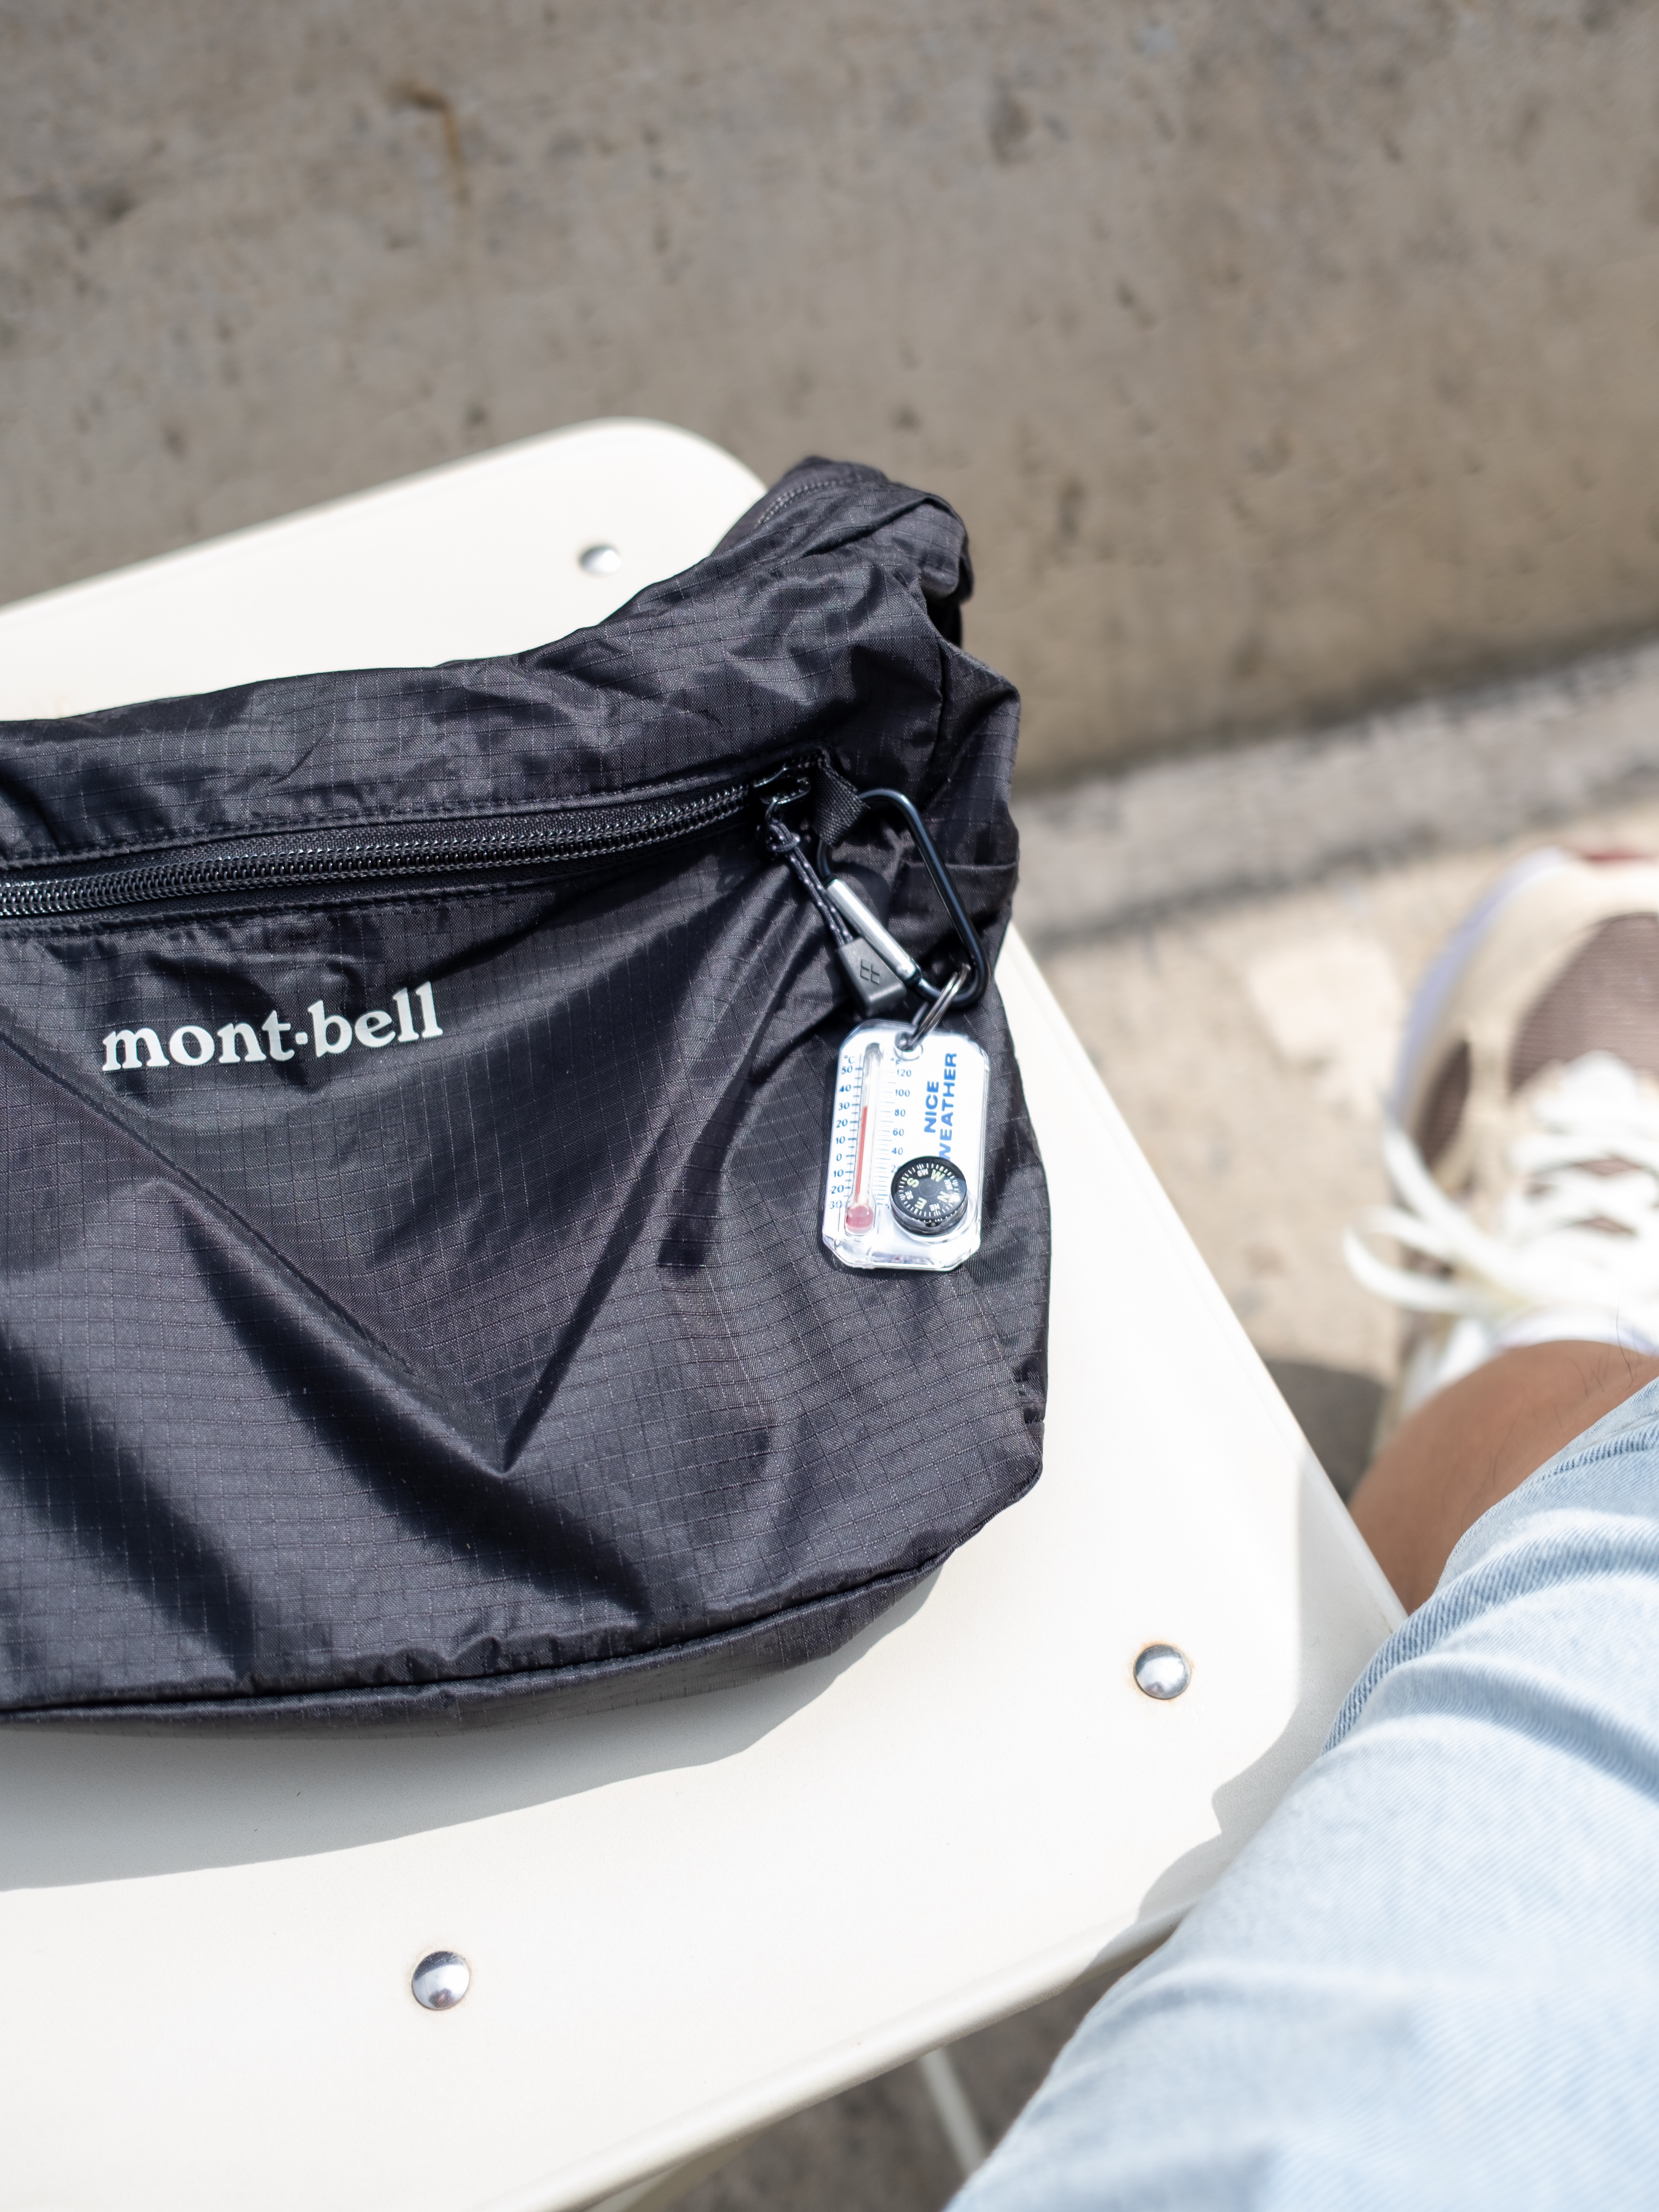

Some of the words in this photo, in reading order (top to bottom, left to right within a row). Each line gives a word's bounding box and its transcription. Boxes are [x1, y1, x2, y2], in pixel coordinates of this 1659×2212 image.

[841, 1065, 853, 1075] 50
[839, 1084, 851, 1092] 40
[838, 1102, 850, 1111] 30
[924, 1080, 939, 1133] NICE
[939, 1053, 957, 1161] WEATHER
[894, 1108, 906, 1117] 80
[836, 1119, 848, 1128] 20
[893, 1128, 904, 1136] 60
[917, 1169, 928, 1177] SW
[931, 1169, 945, 1183] W
[907, 1177, 919, 1188] S
[937, 1191, 952, 1203] N
[914, 1197, 927, 1210] E
[929, 1203, 940, 1212] NE
